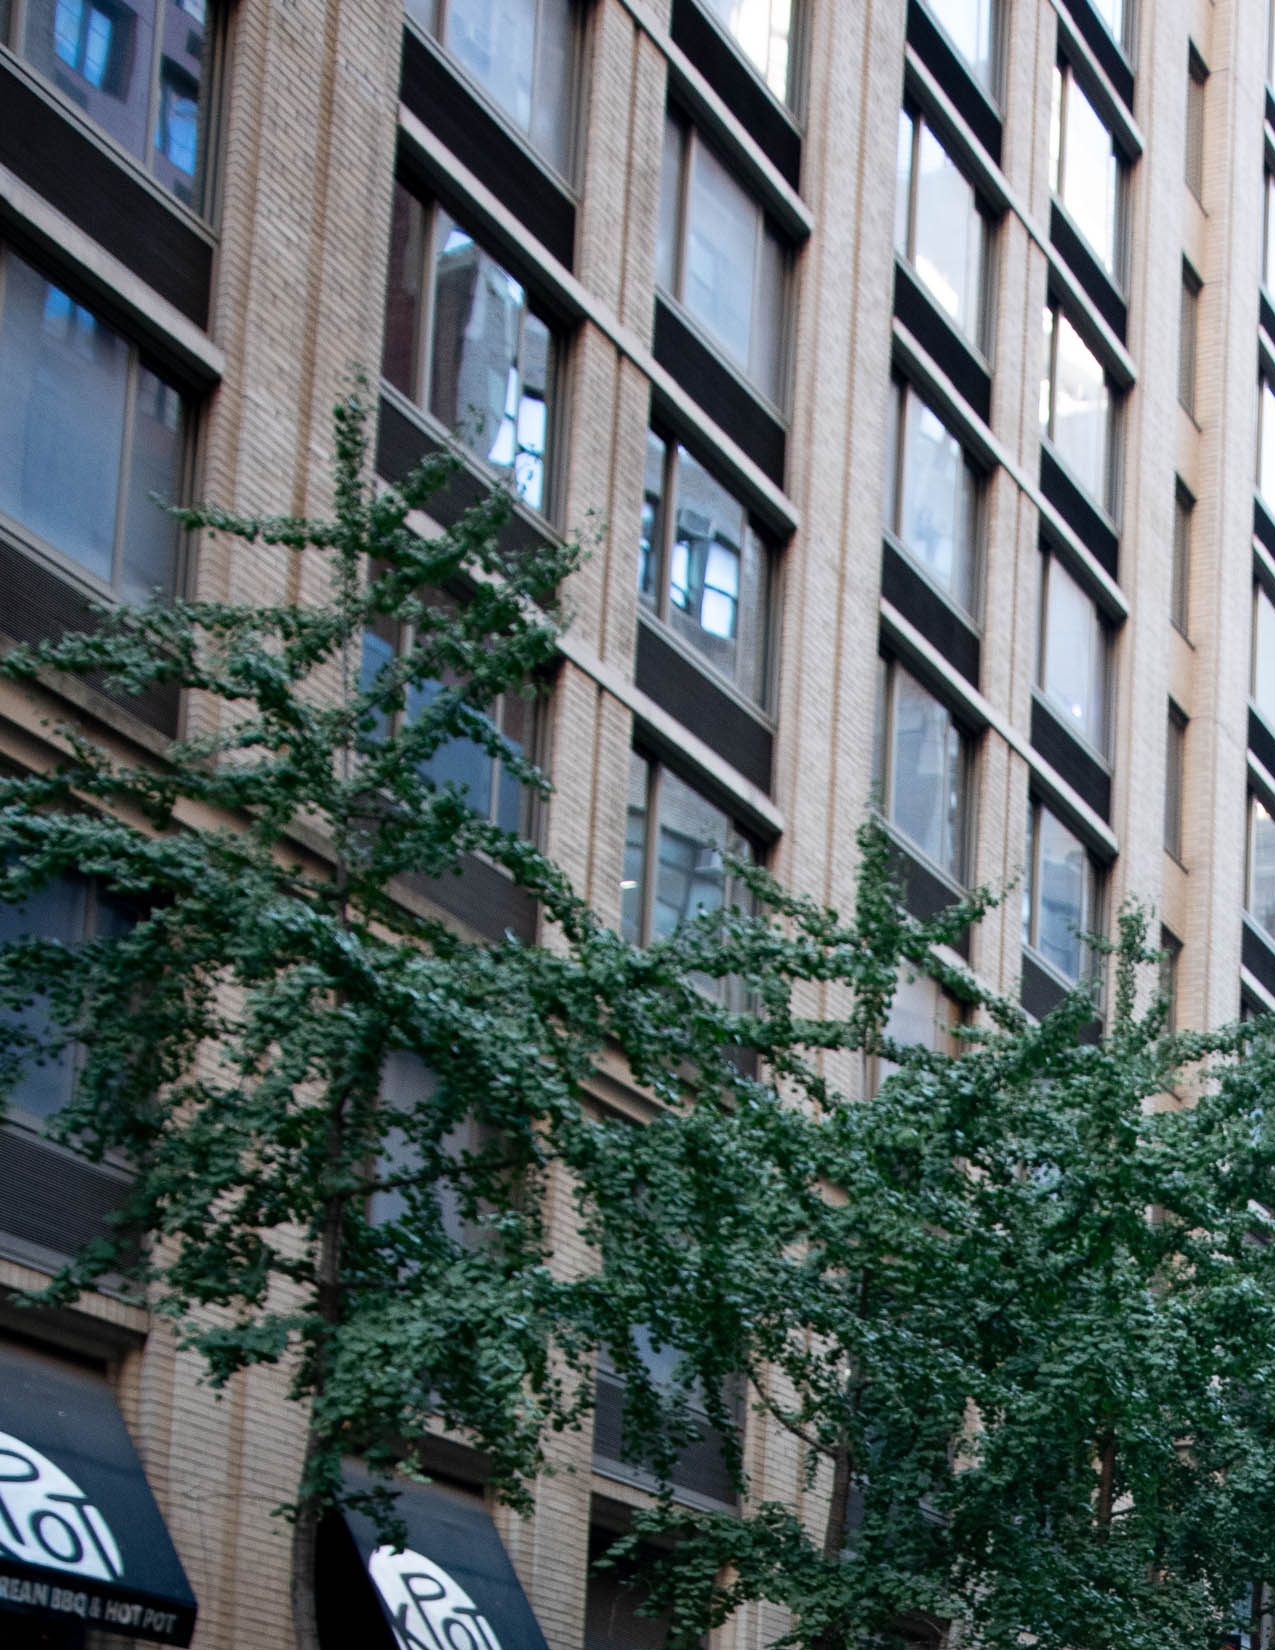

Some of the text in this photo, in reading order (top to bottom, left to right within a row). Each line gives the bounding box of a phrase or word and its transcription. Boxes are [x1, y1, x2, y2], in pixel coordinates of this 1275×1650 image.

[0, 1576, 177, 1634] REAN BBQ & HOT POT
